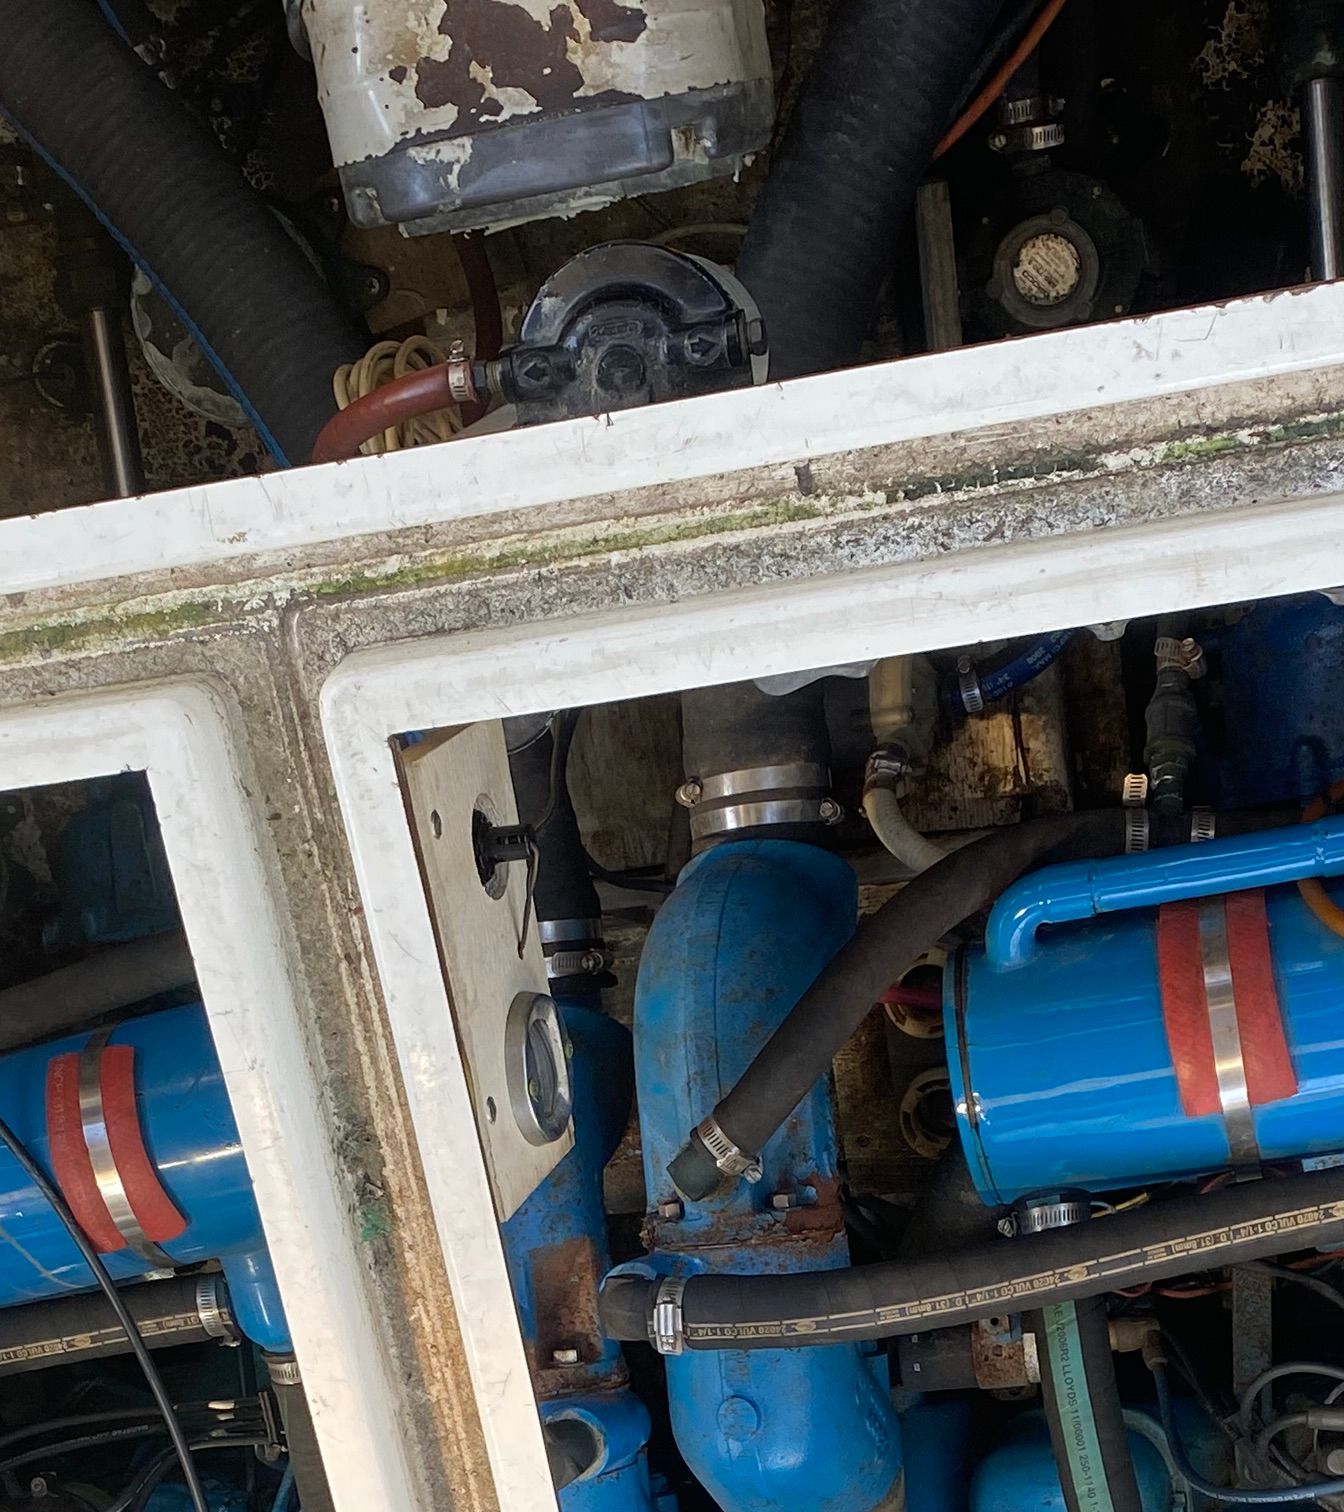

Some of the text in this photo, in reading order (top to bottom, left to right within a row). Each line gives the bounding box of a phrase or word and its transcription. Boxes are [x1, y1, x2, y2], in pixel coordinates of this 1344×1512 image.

[1265, 1216, 1296, 1230] VULCO
[1000, 1281, 1031, 1294] VULCO
[724, 1326, 756, 1336] VULCO
[16, 1345, 43, 1356] VULCO
[1062, 1364, 1078, 1406] LLOYDS
[1079, 1454, 1097, 1499] 250-1140
